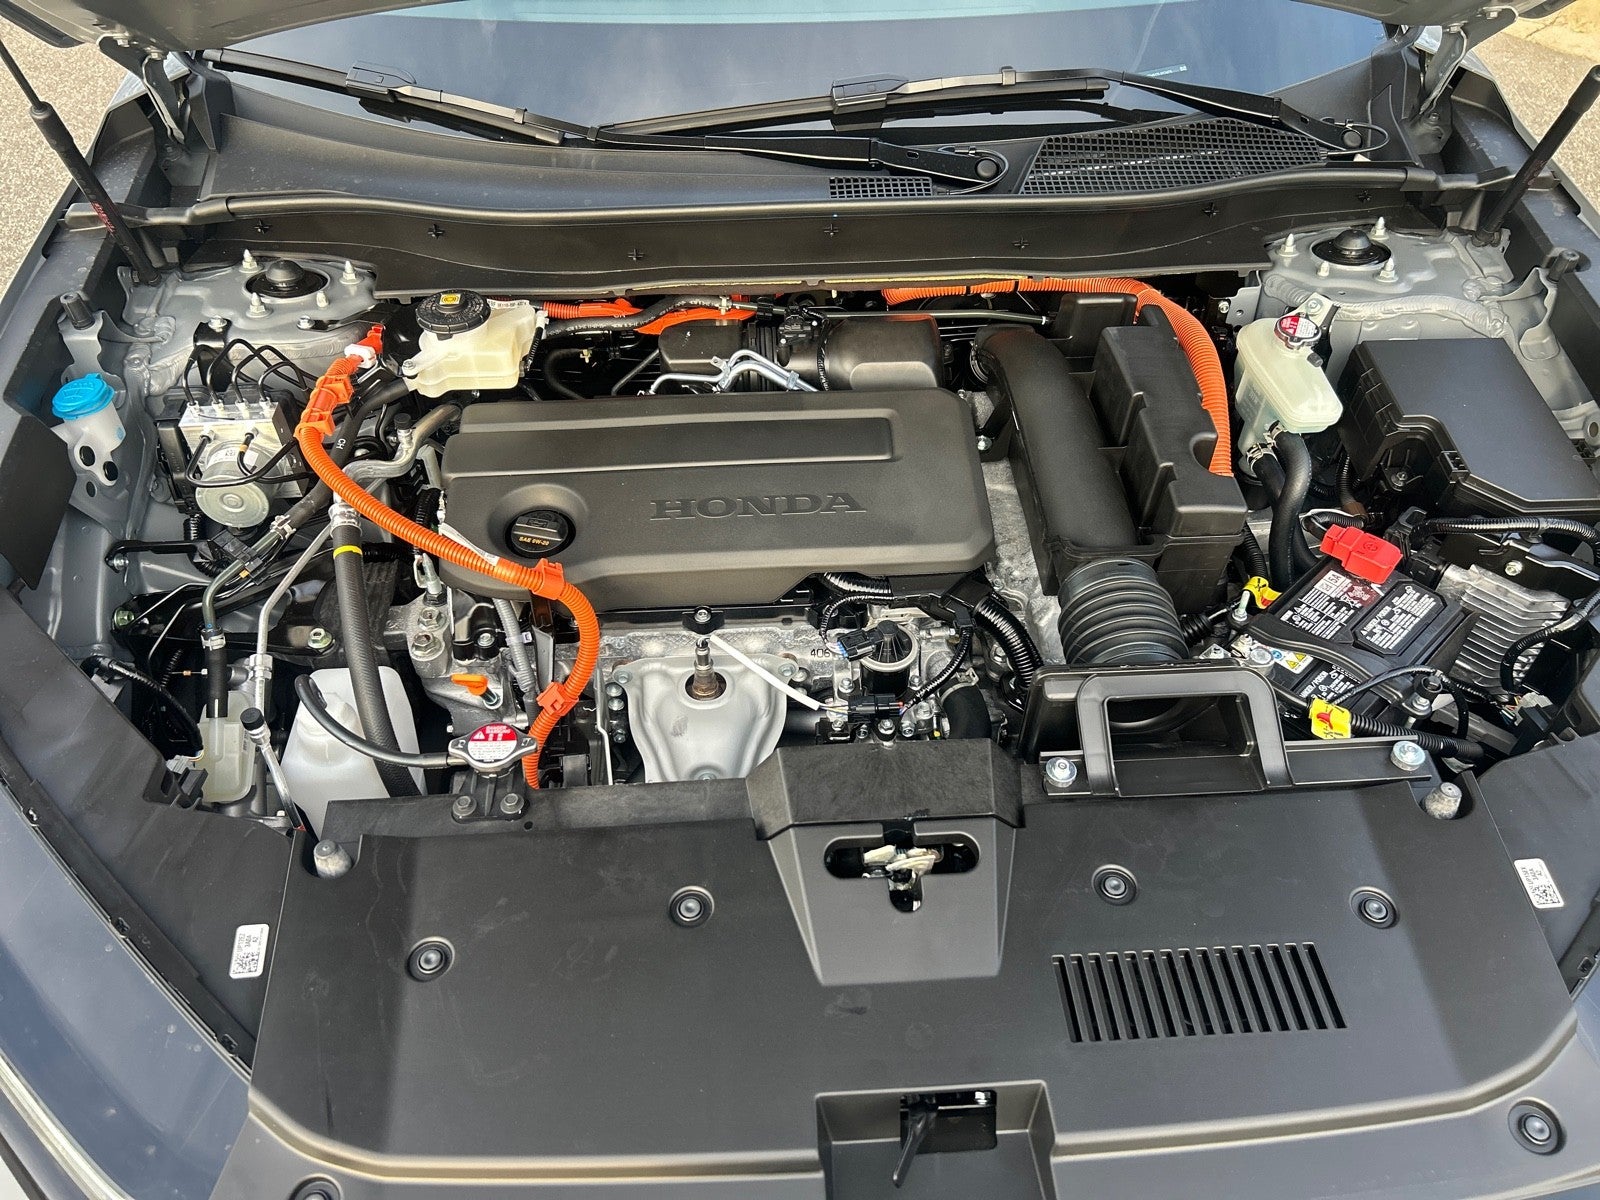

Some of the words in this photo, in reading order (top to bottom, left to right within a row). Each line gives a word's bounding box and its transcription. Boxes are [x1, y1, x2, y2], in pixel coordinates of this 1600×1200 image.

[336, 438, 346, 450] CH
[650, 492, 867, 520] HONDA
[518, 536, 532, 544] SAE
[810, 648, 831, 658] 406
